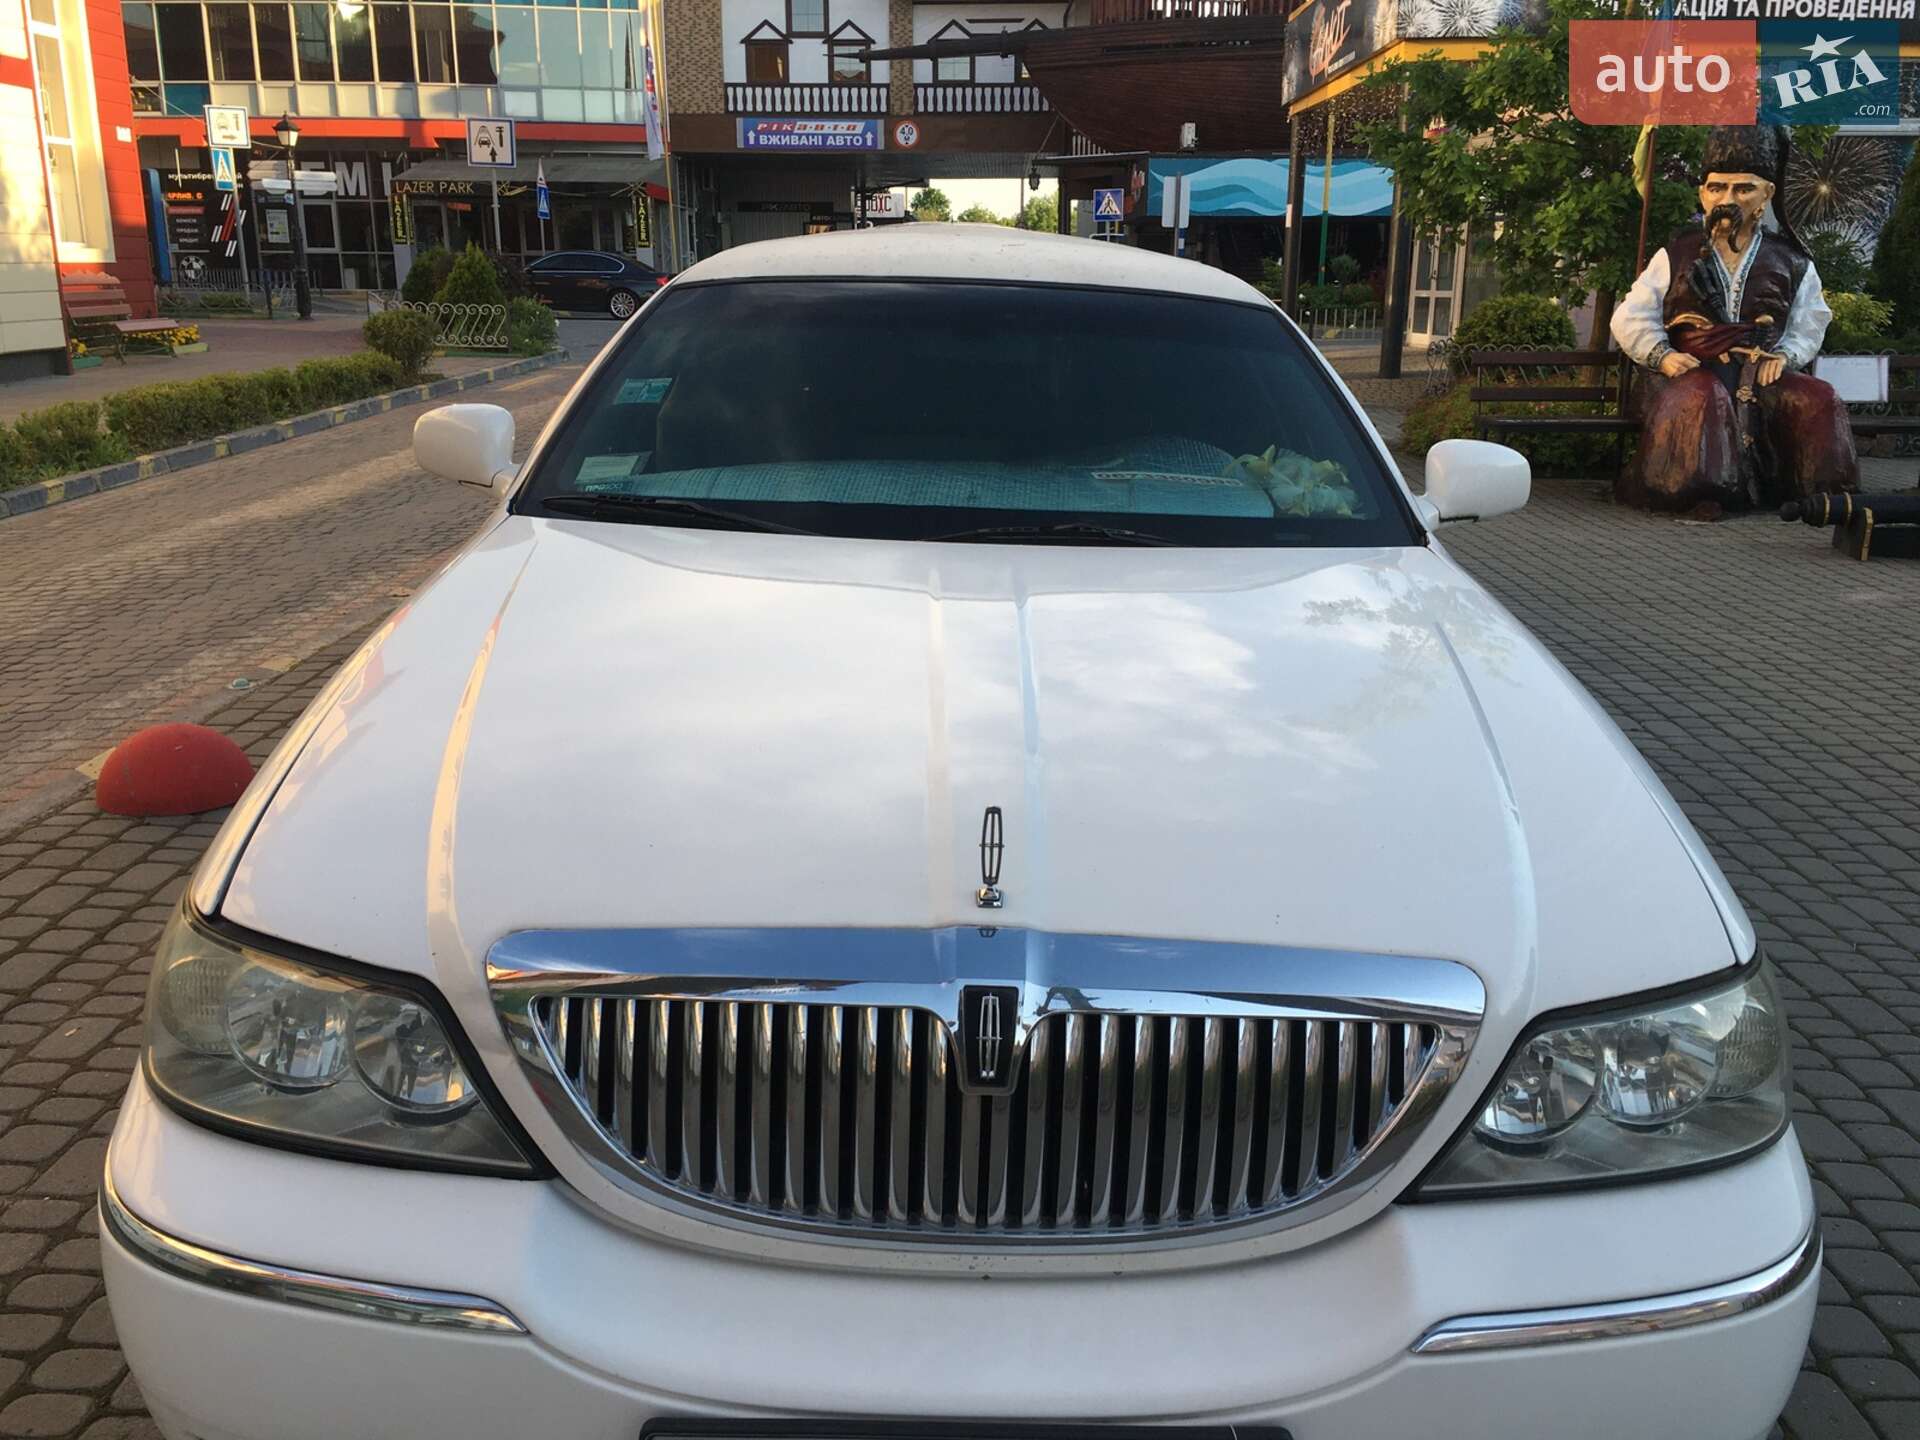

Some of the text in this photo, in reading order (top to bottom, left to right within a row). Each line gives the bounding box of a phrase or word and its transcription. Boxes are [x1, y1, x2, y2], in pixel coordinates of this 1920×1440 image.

[1736, 0, 1760, 18] ТА
[1765, 0, 1916, 21] ПРОВЕДЕННЯ
[759, 135, 863, 146] ВЖИВАНІ АВТО
[395, 181, 475, 194] LAZER PARK
